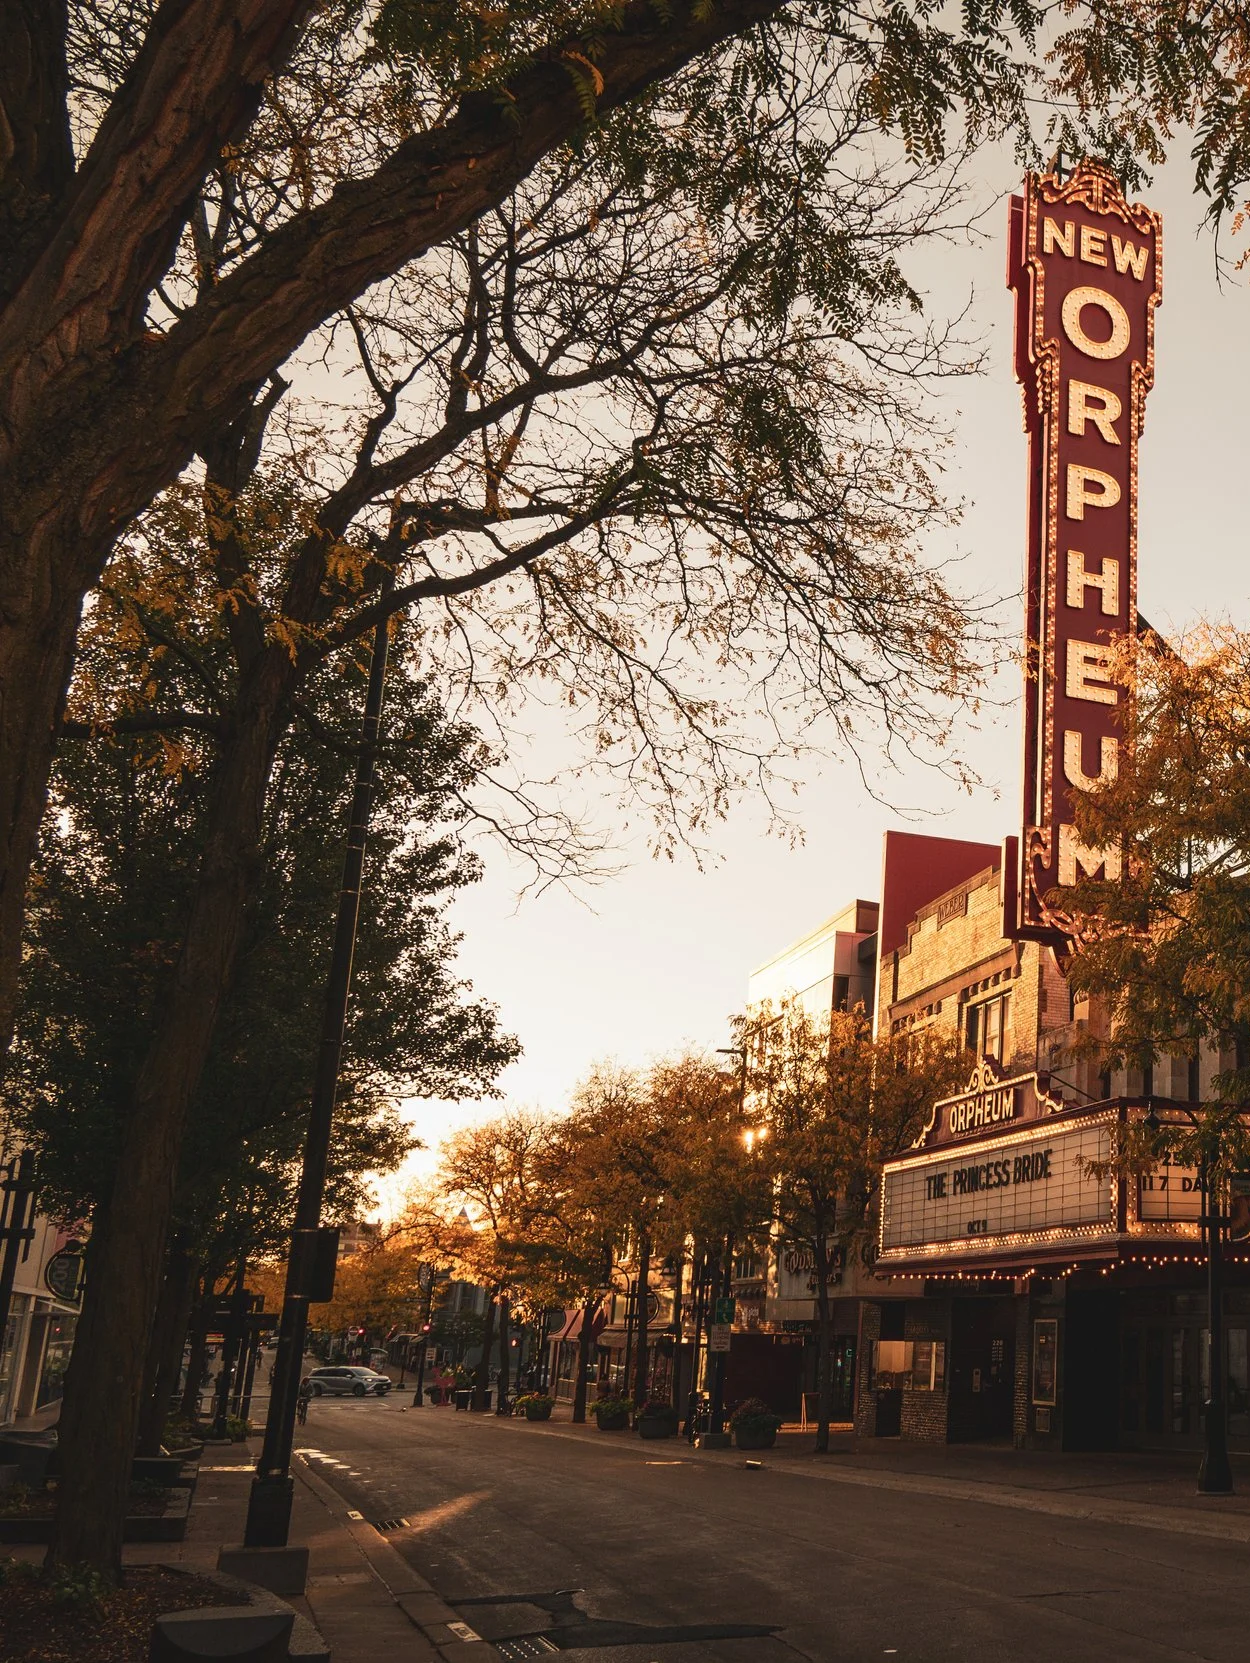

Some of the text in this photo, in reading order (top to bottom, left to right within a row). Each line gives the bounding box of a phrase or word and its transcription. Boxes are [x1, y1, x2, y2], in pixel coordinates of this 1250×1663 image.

[1043, 216, 1149, 281] NEW
[1058, 286, 1131, 887] ORPHEUM
[938, 894, 964, 921] WEBER
[950, 1088, 1014, 1133] ORPHEUM
[926, 1149, 1053, 1200] THE PRINCESS BRIDE
[967, 1220, 981, 1234] OCT
